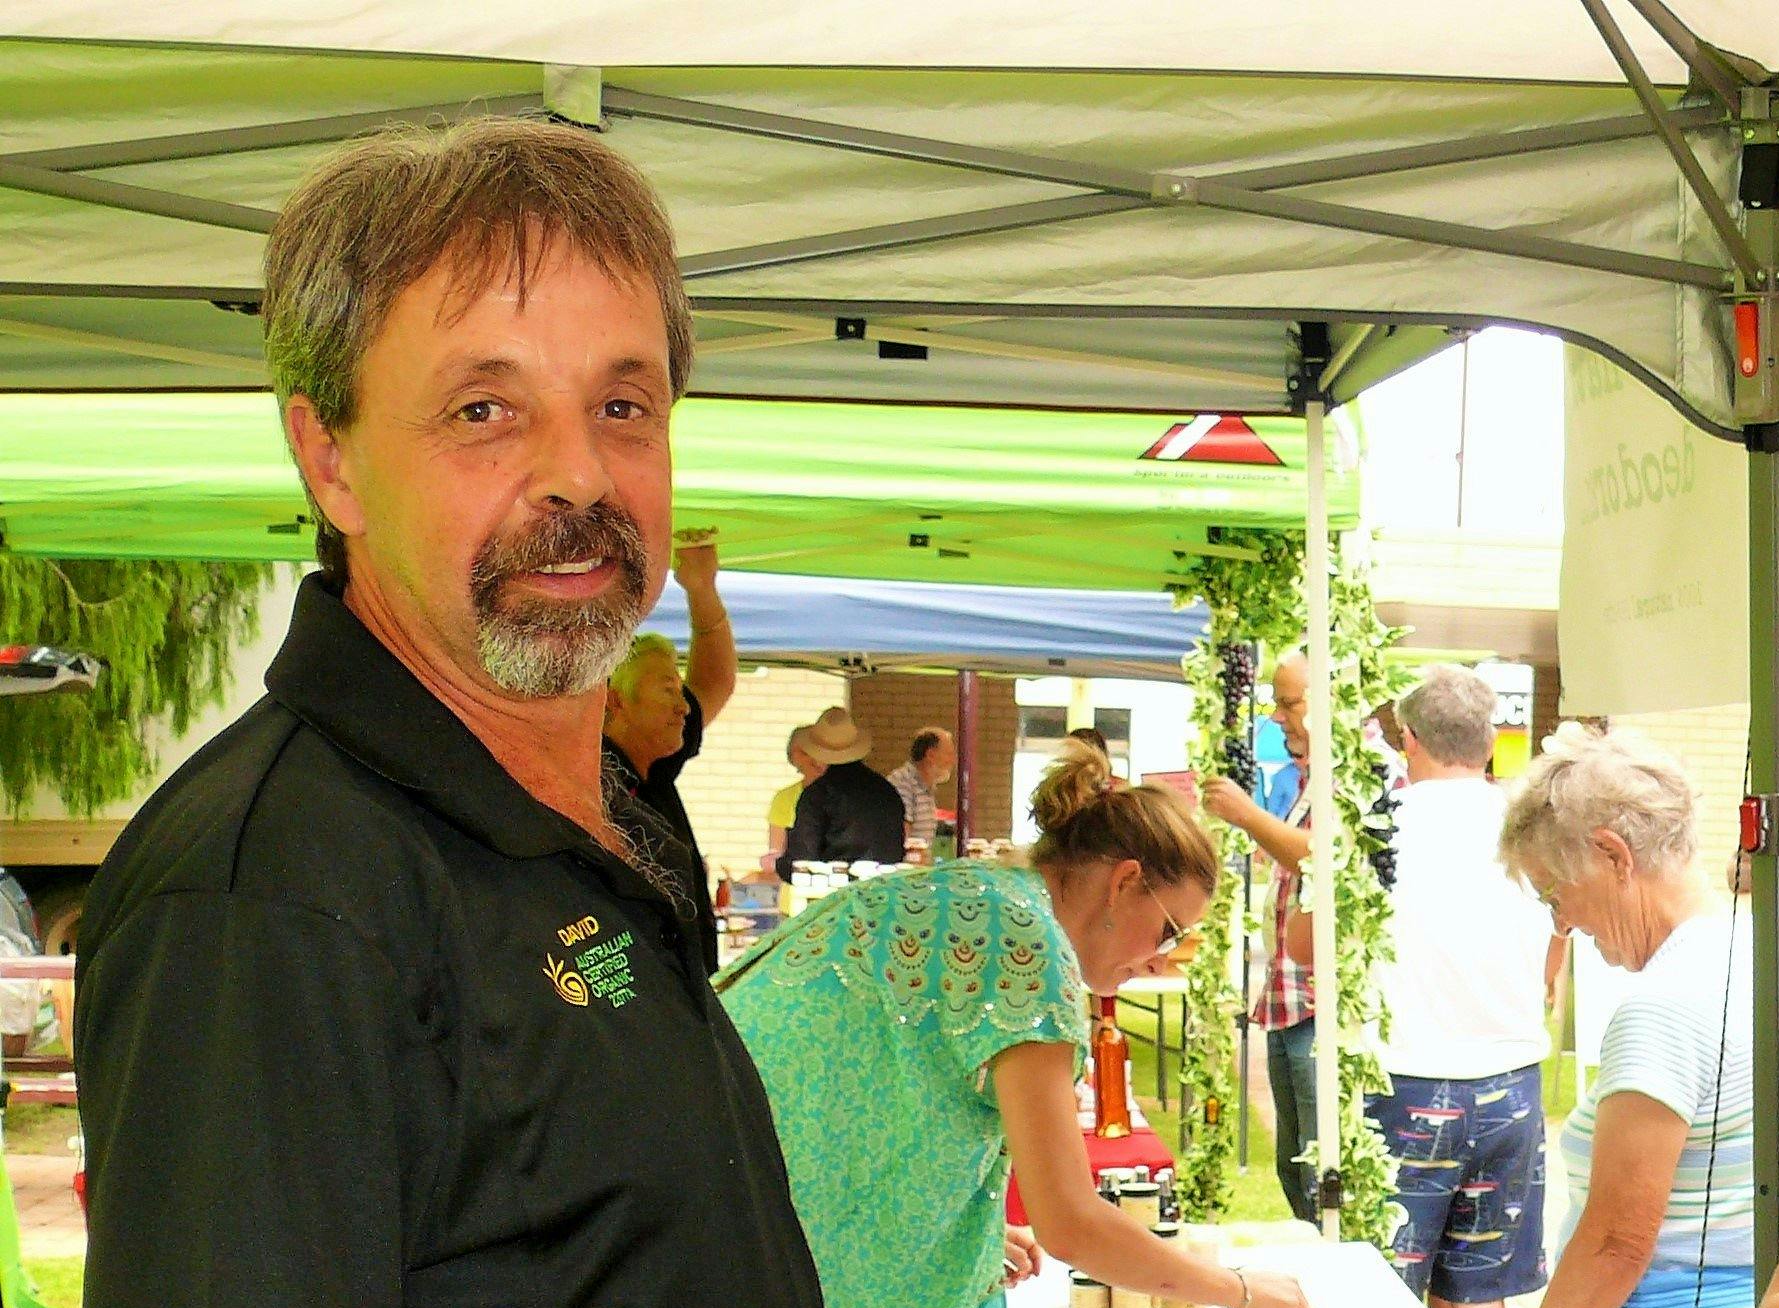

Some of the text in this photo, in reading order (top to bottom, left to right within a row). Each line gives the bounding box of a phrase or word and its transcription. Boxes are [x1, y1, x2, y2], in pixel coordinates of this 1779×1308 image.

[557, 915, 600, 947] DAVID
[575, 931, 634, 970] AUSTRALIAN
[583, 953, 629, 983] CERTIFIED
[591, 968, 635, 998] ORGANIC
